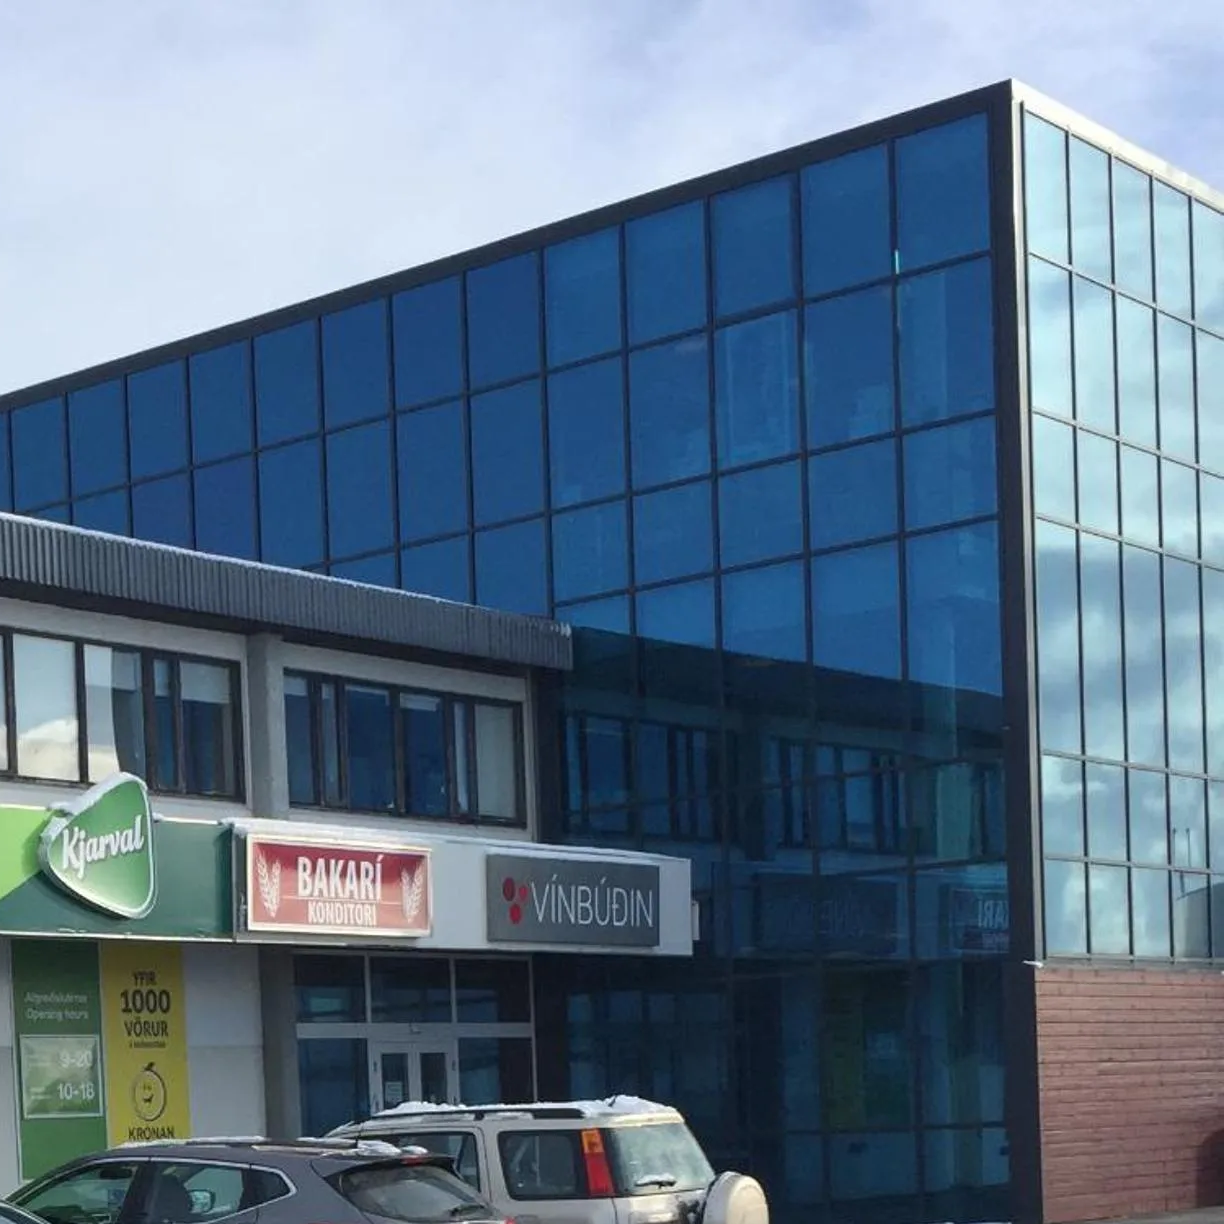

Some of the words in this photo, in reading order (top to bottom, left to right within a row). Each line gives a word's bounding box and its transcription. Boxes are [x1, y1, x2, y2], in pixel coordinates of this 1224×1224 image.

[62, 814, 145, 880] Kjarval
[297, 854, 384, 900] BAKARÍ
[307, 899, 377, 926] KONDITORI
[531, 874, 654, 928] VÍNBÚÐIN
[120, 989, 171, 1014] 1000
[124, 1016, 169, 1037] VÖRUR
